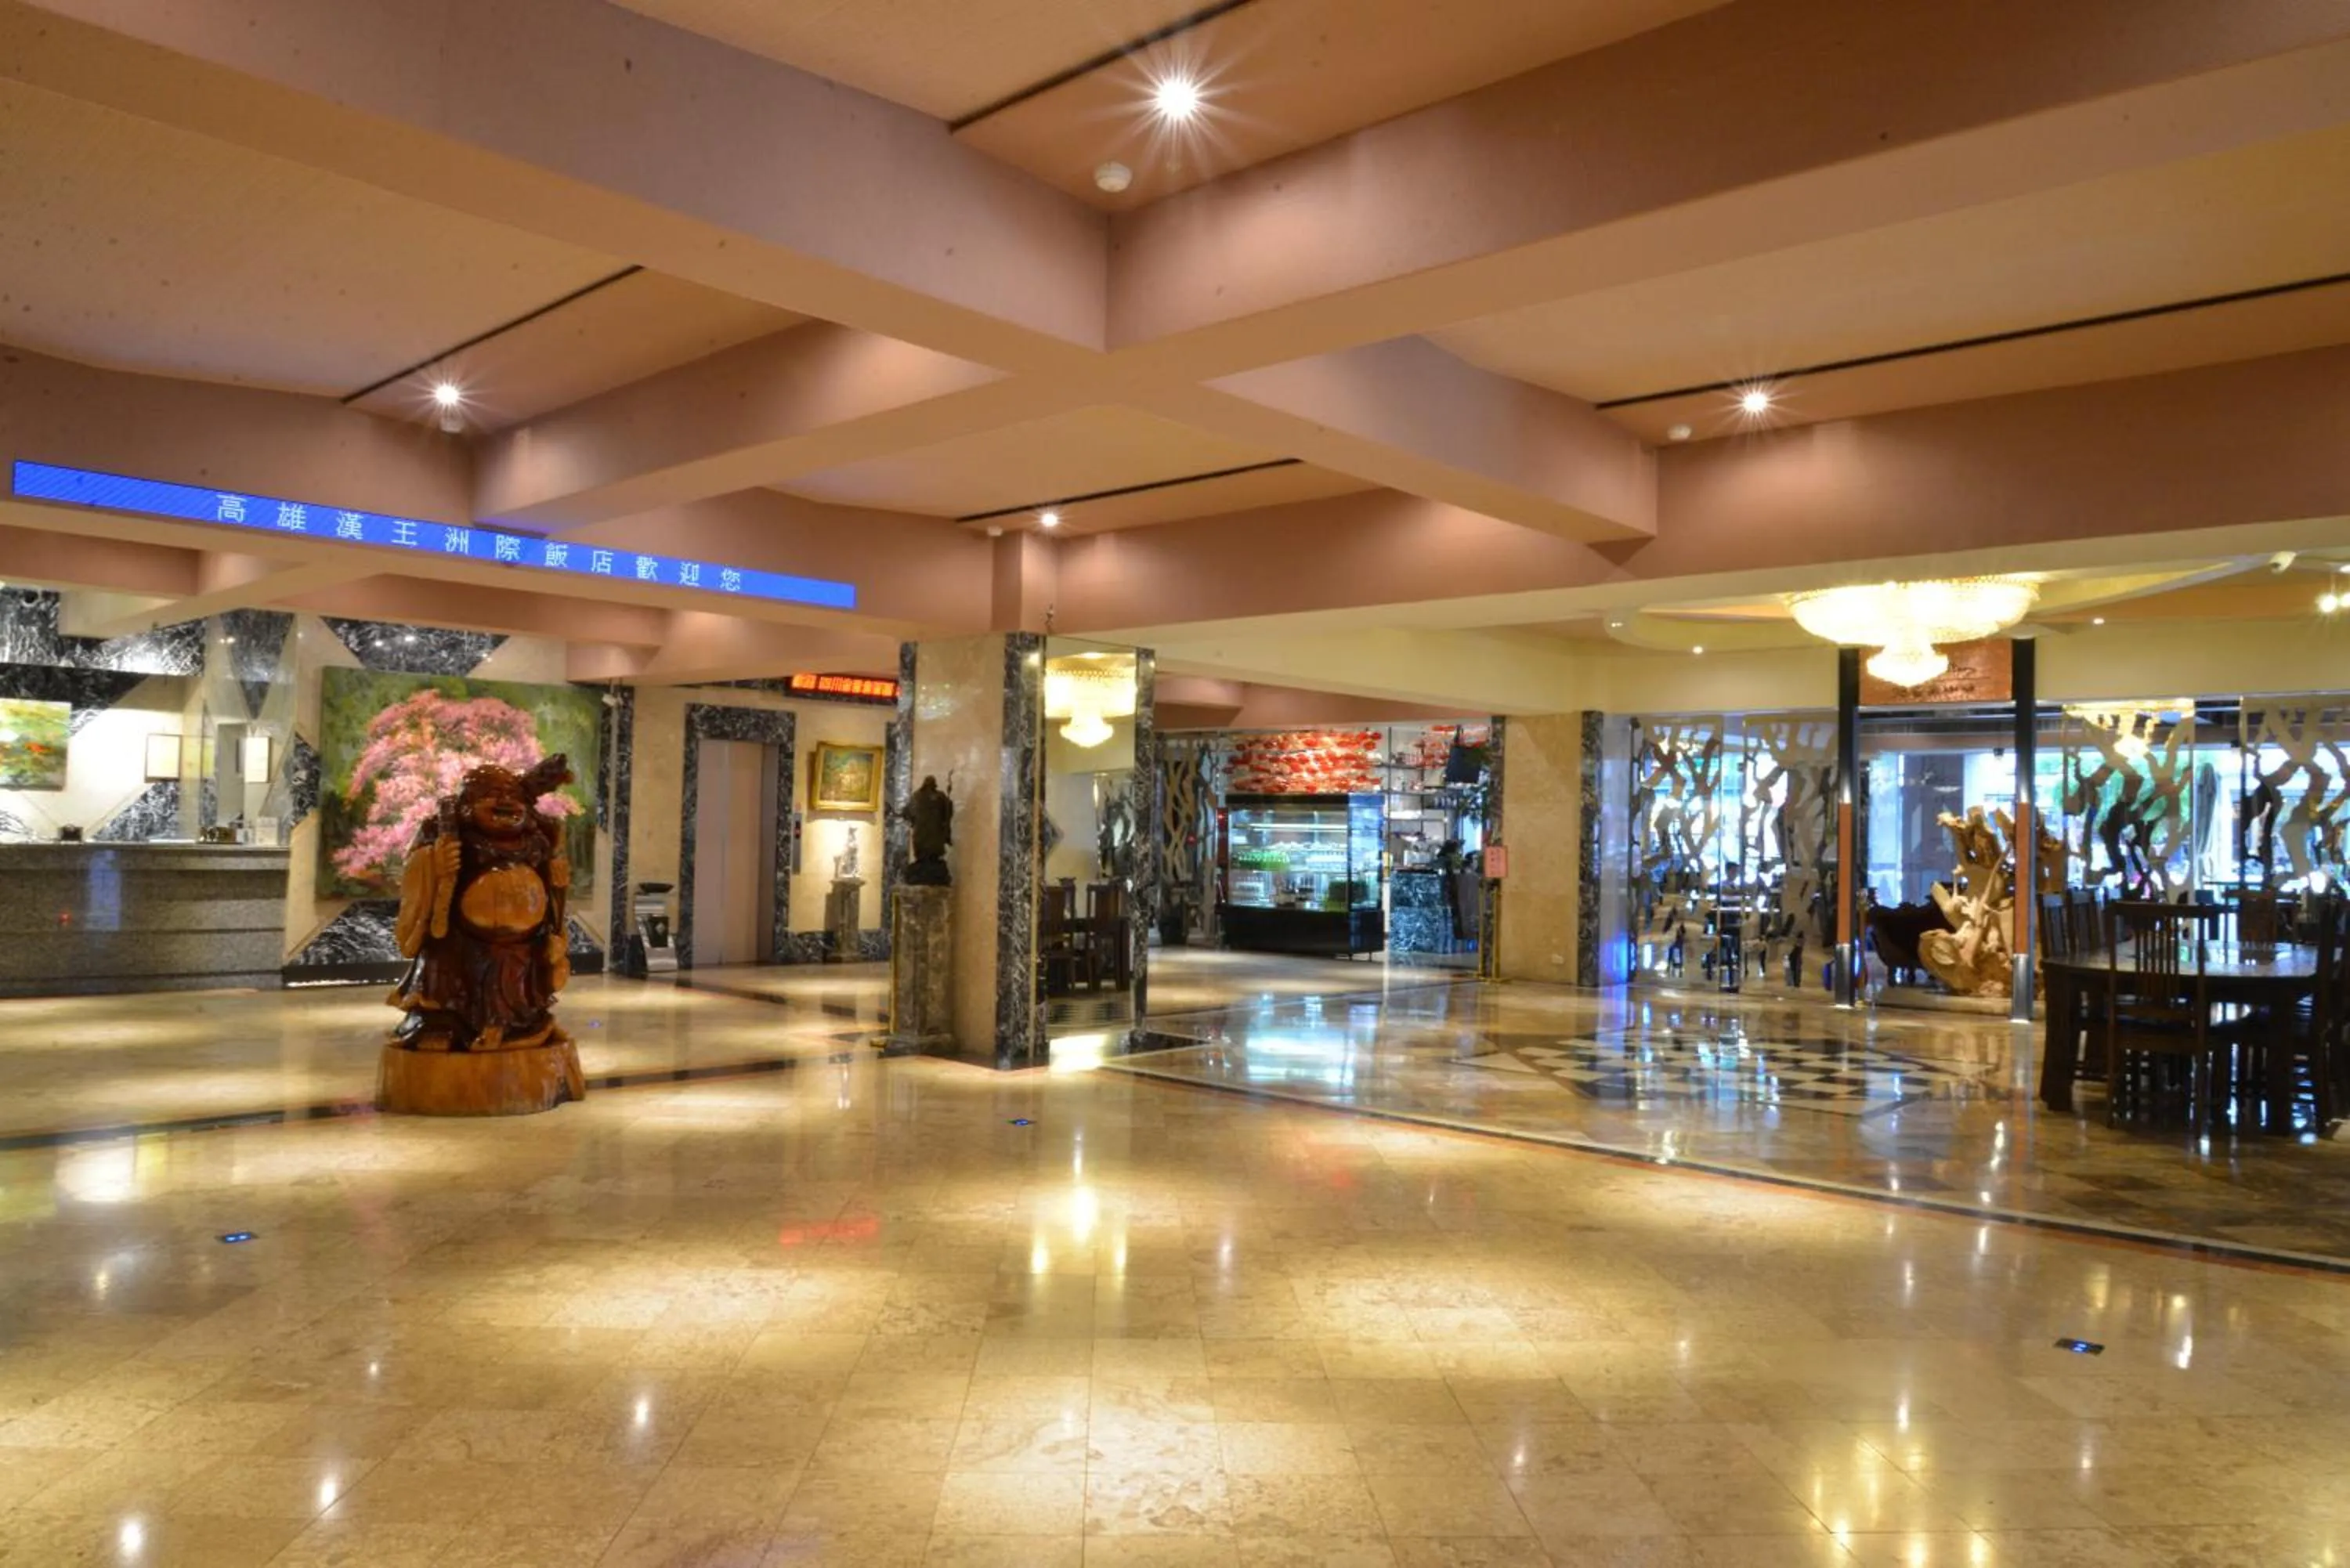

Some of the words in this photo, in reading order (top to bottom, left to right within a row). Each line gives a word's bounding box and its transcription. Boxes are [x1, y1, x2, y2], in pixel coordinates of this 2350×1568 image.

[217, 493, 741, 592] 高雄漢王洲際飯店歡迎您
